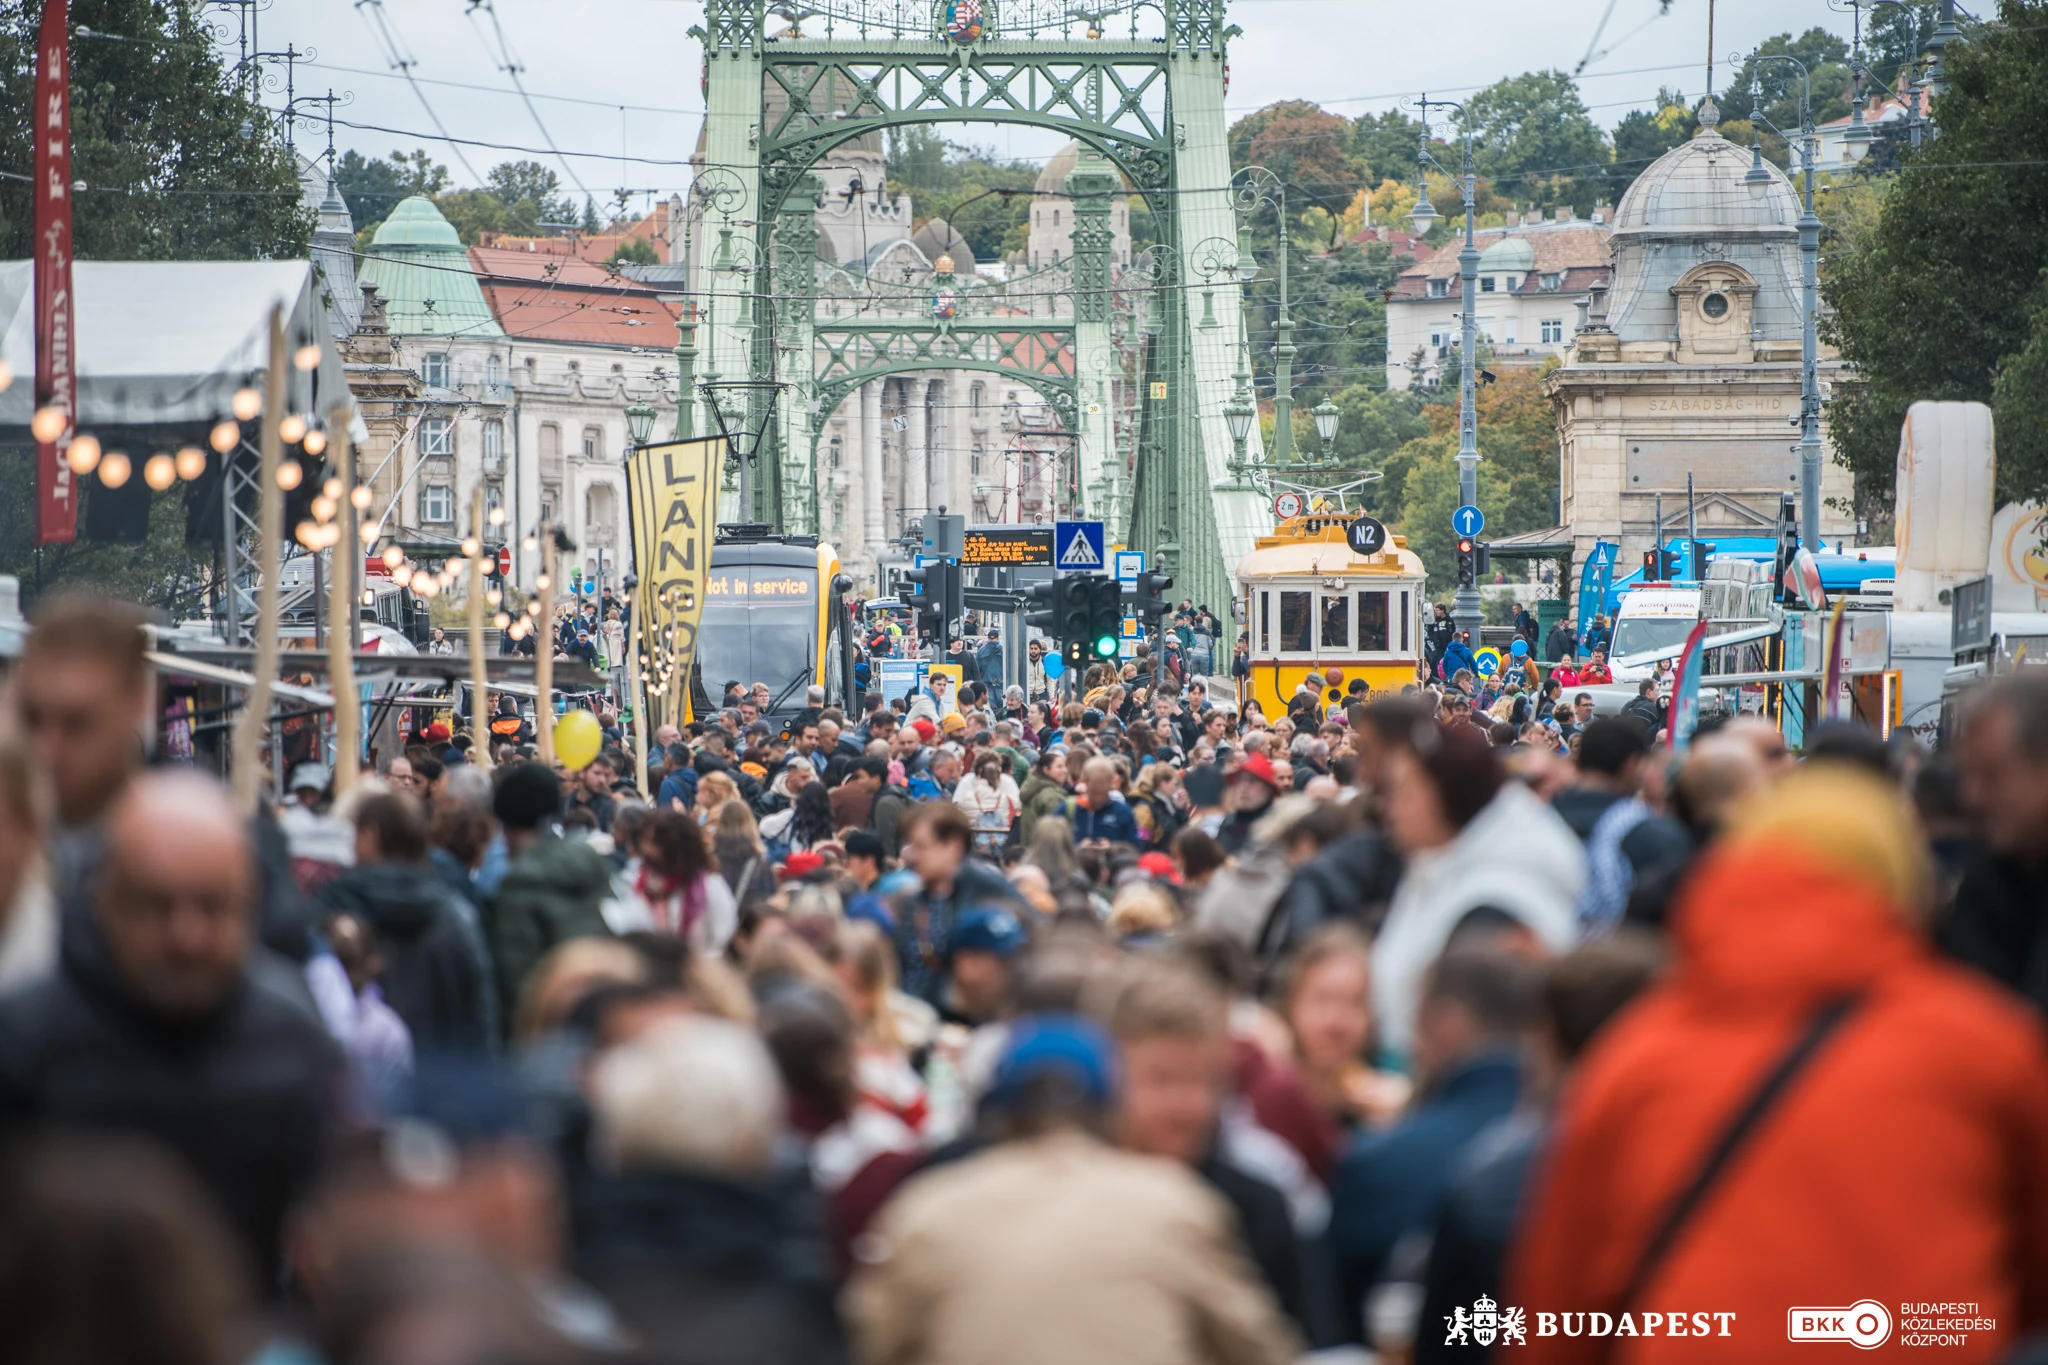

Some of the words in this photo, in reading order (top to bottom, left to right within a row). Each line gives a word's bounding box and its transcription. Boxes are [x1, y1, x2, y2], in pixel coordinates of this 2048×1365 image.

[47, 45, 64, 200] FIRE
[1281, 501, 1286, 511] 2
[1287, 502, 1295, 511] m
[1355, 525, 1375, 545] N2
[734, 579, 748, 595] in
[753, 579, 808, 595] service
